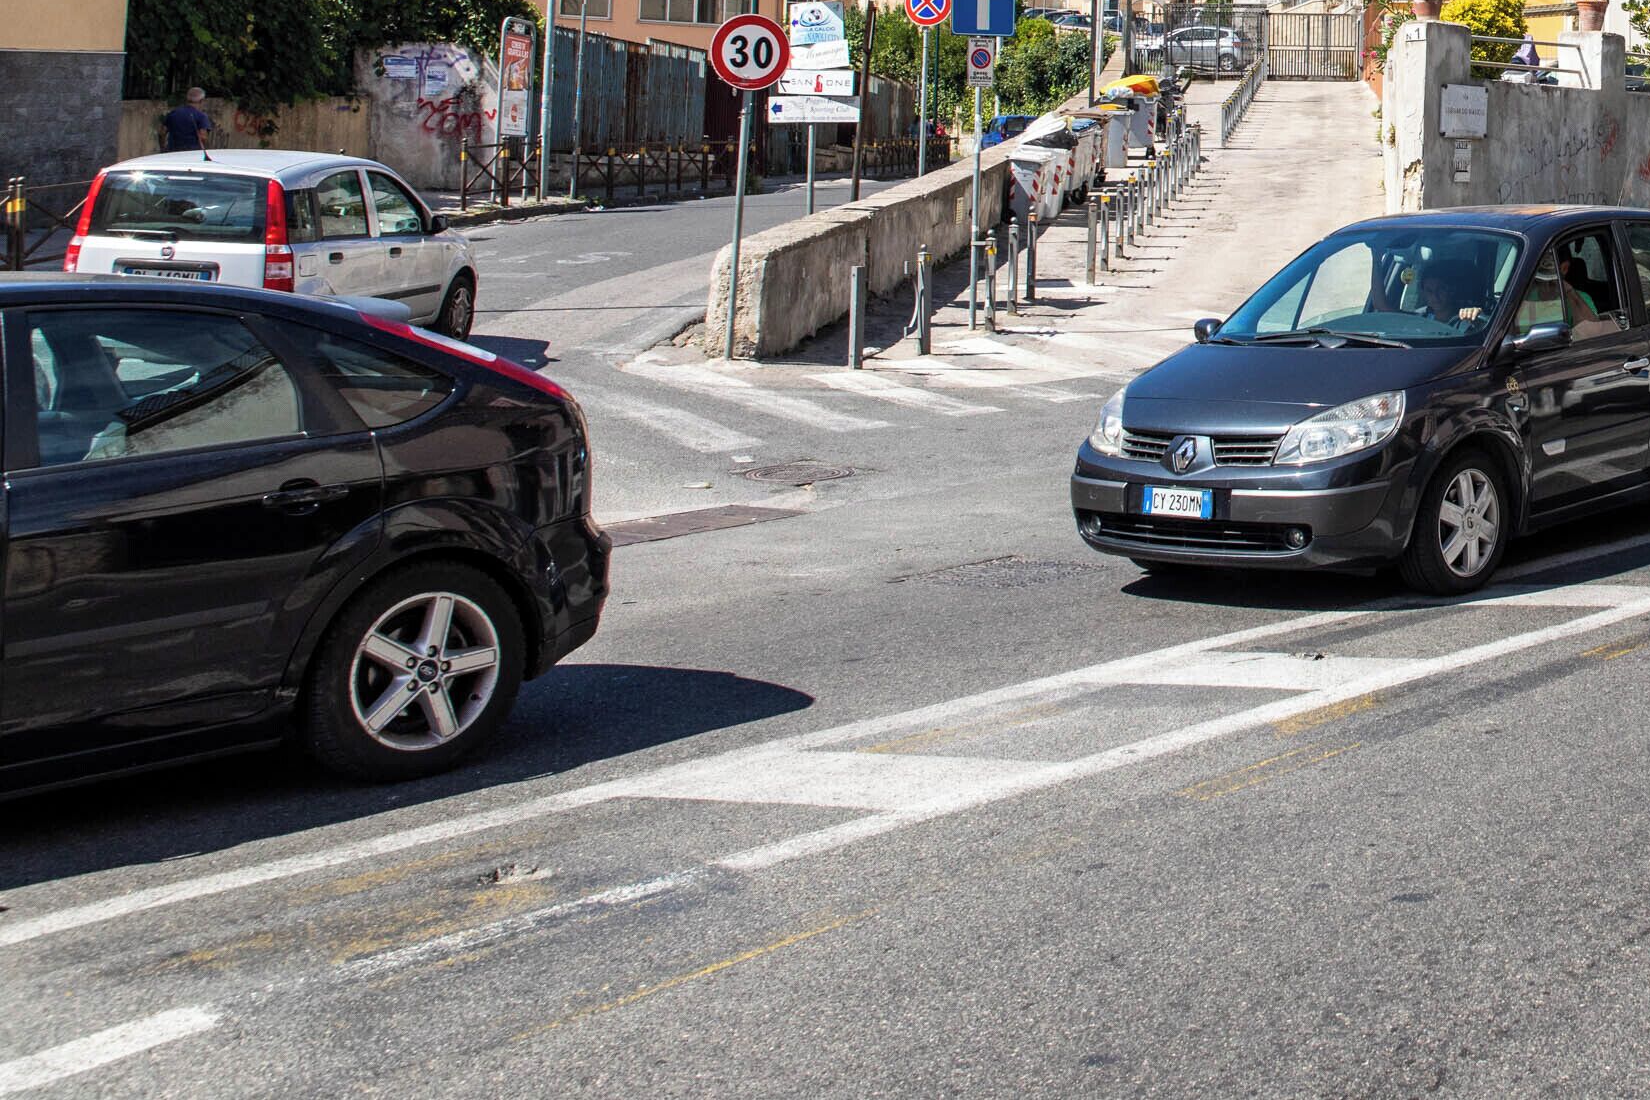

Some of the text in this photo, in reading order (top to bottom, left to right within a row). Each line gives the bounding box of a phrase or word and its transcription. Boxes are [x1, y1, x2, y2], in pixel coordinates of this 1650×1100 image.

[730, 35, 774, 69] 30
[1153, 493, 1166, 509] CY
[1169, 494, 1201, 512] 230MN
